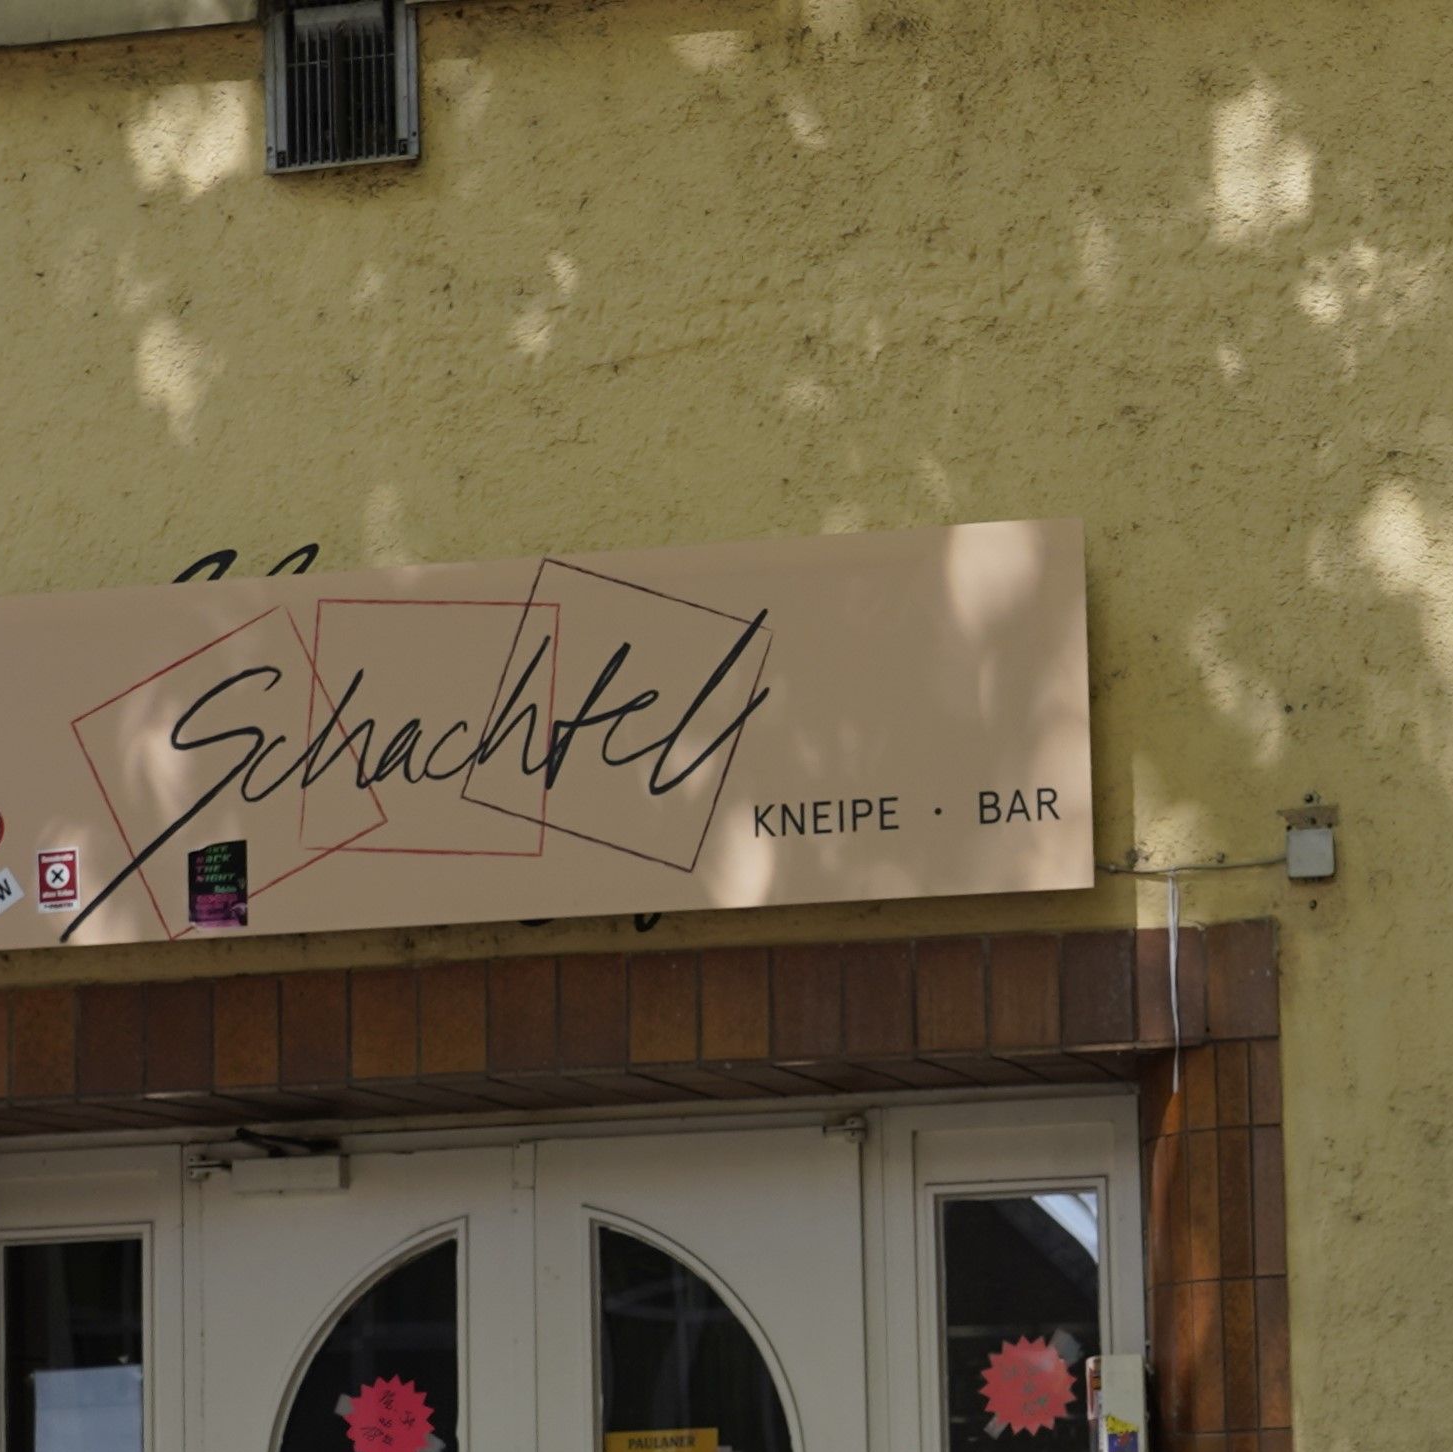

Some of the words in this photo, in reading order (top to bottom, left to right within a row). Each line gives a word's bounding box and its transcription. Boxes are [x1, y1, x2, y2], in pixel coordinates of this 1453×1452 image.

[754, 797, 899, 838] KNEIPE
[978, 788, 1060, 825] BAR
[628, 1435, 696, 1450] PAULANER
